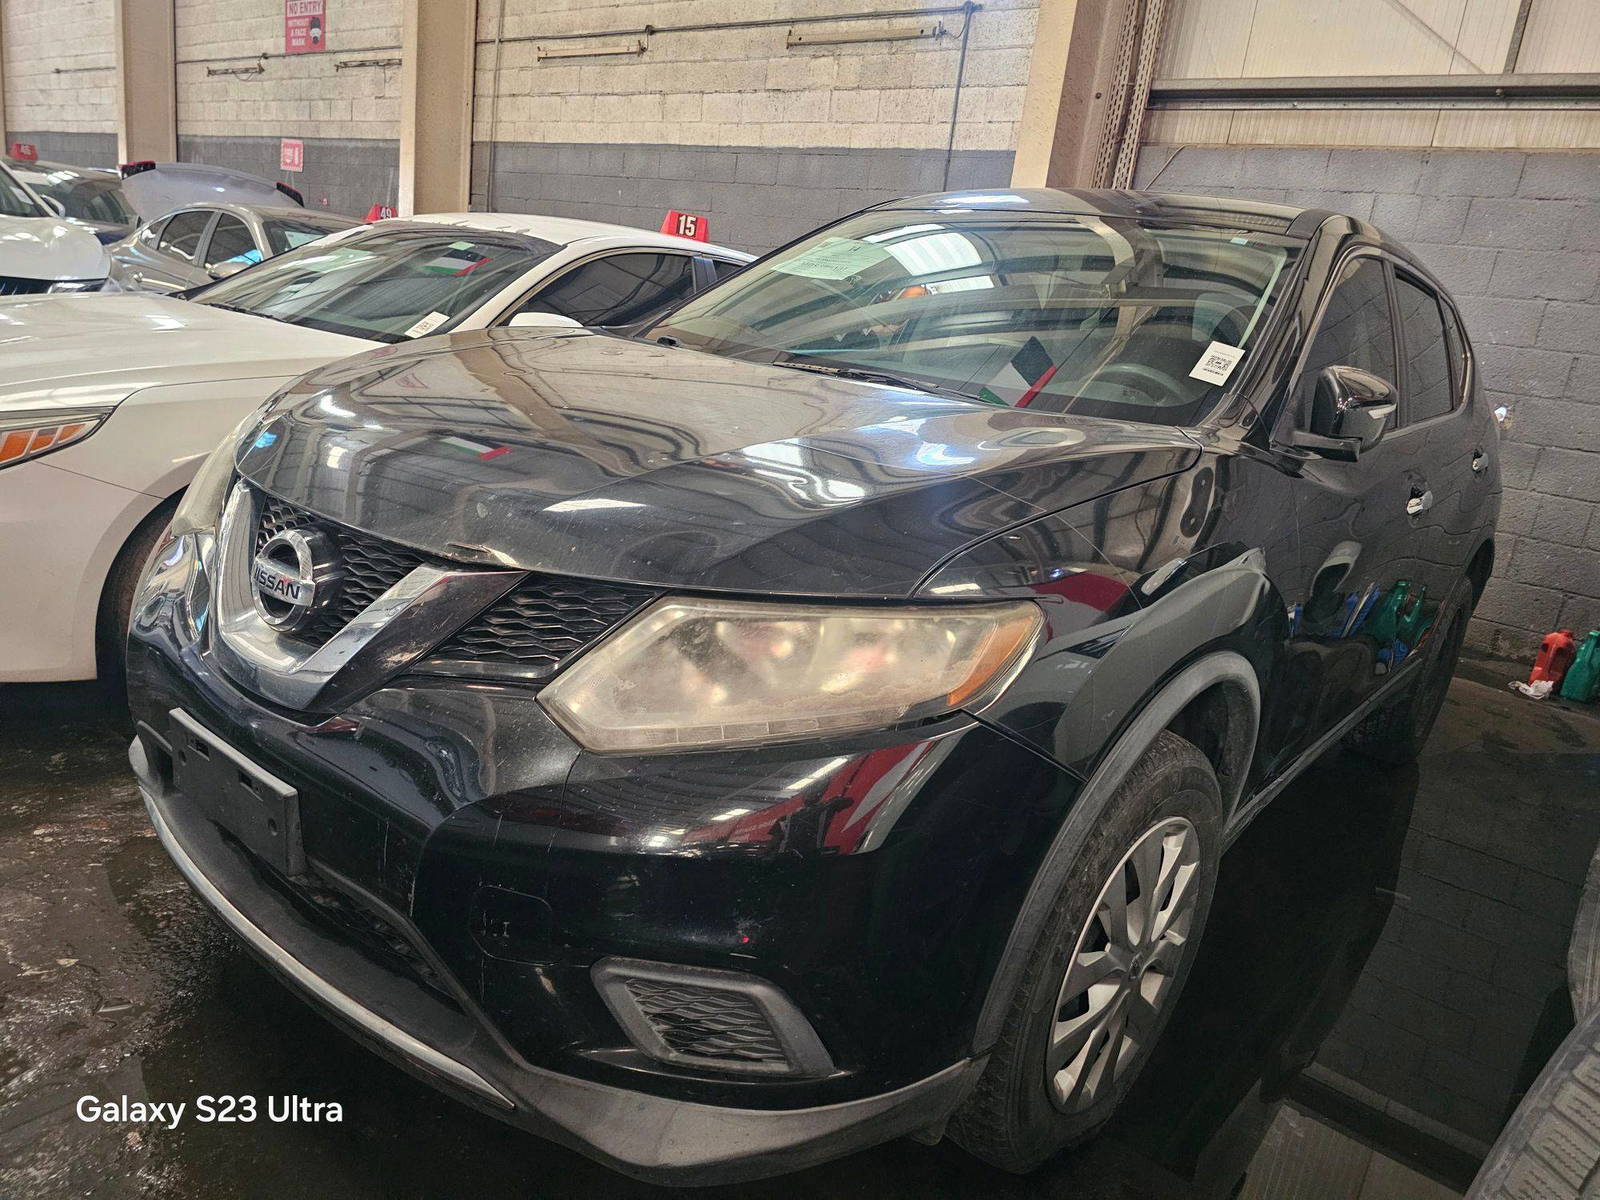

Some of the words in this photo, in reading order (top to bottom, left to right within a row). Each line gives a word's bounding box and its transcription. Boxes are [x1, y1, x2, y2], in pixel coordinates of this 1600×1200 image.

[288, 2, 298, 15] NO
[300, 1, 321, 14] ENTRY
[679, 214, 697, 237] 15
